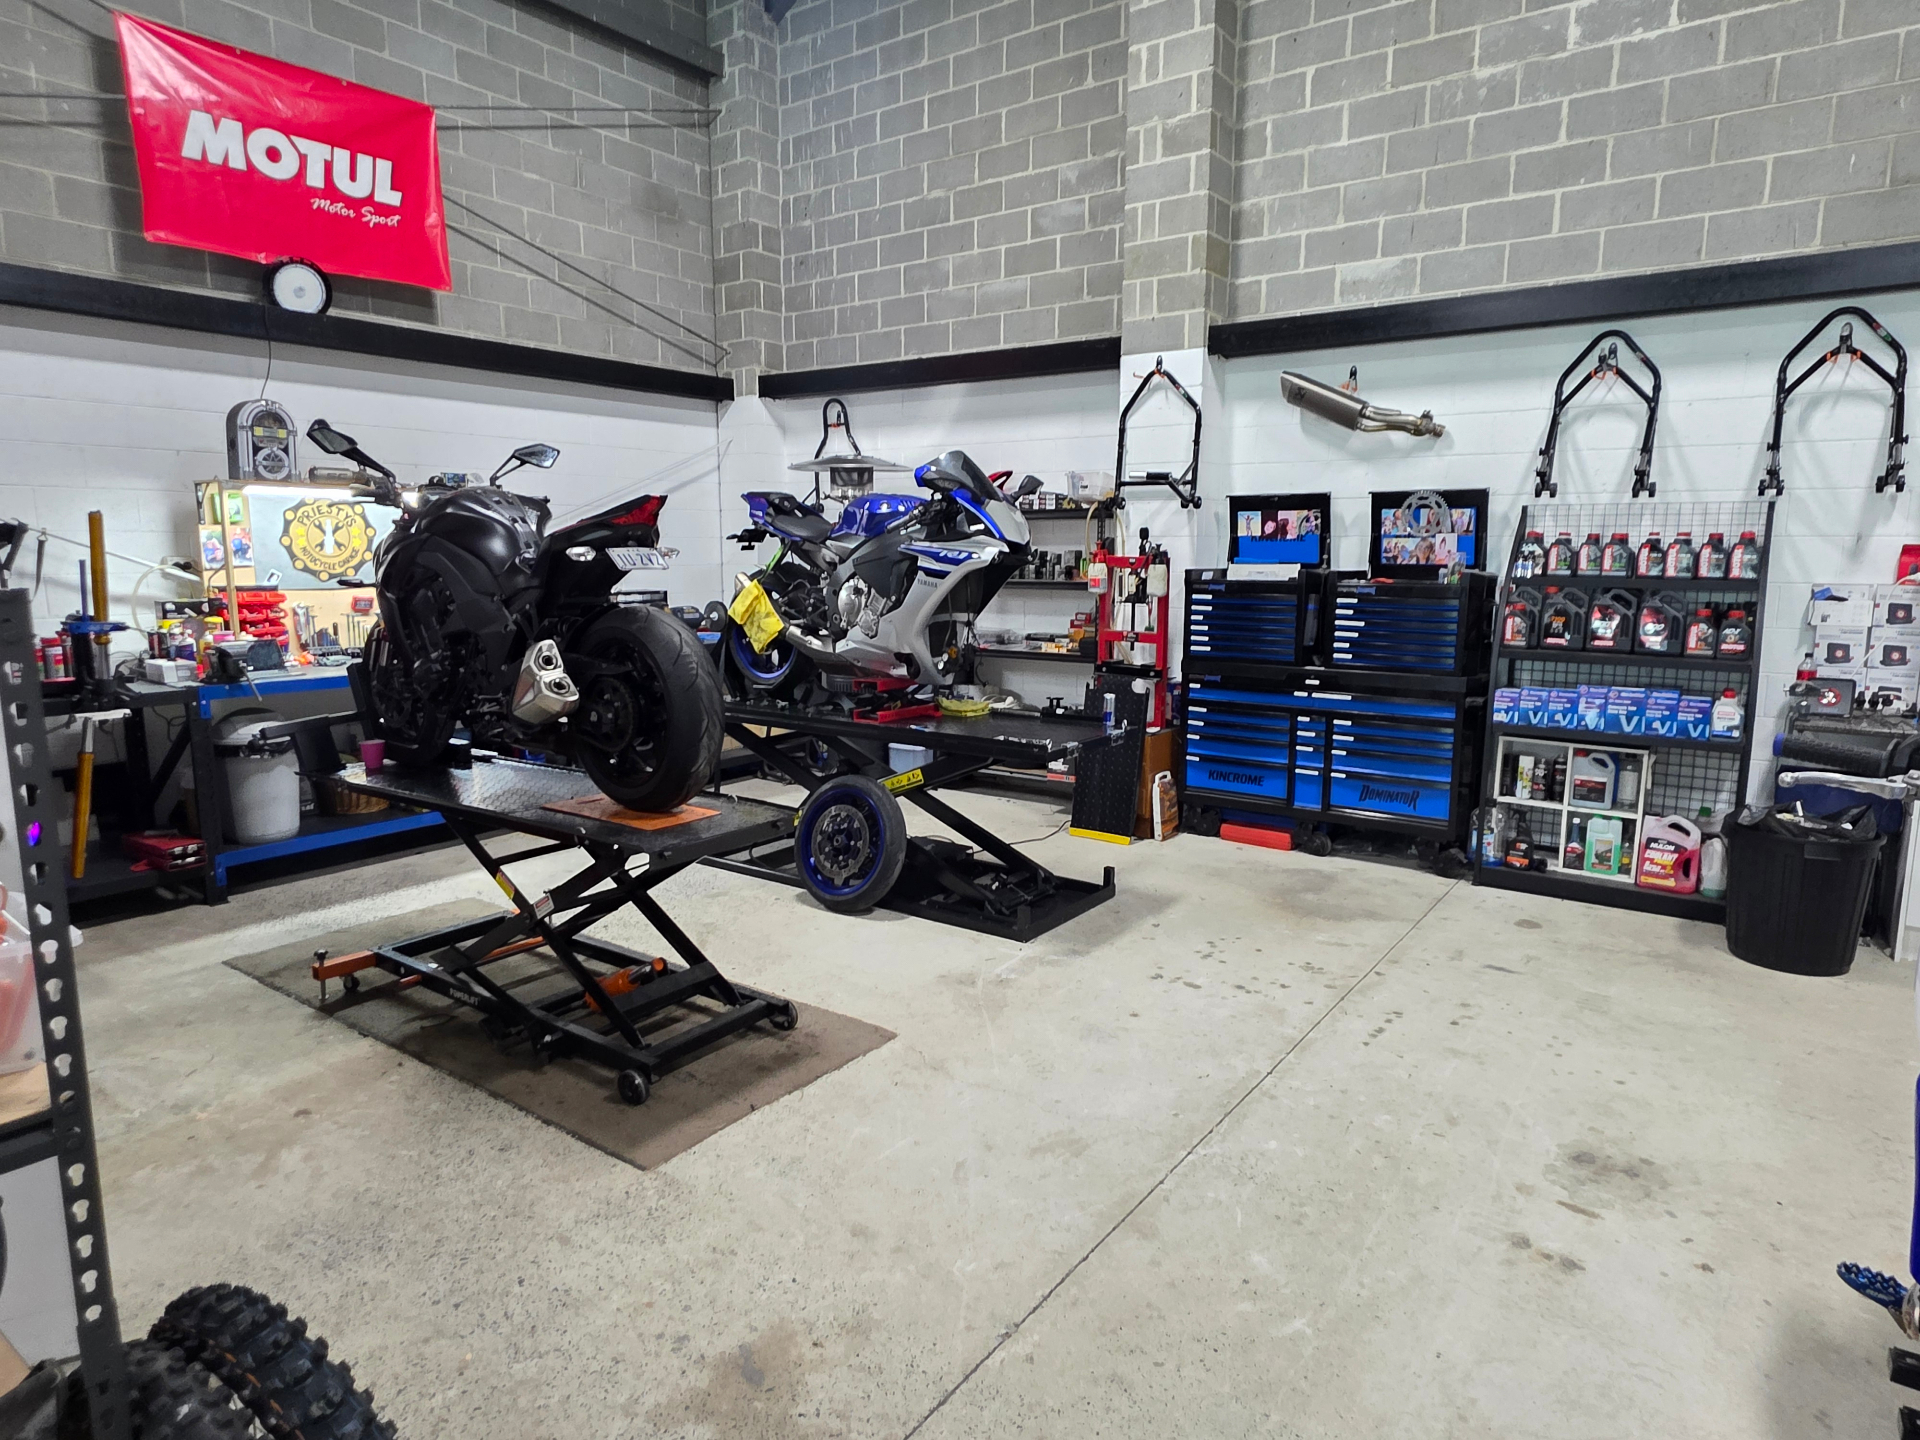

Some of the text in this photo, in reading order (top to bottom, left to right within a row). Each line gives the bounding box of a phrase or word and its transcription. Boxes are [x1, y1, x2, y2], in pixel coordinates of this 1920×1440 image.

[181, 109, 403, 207] MOTUL
[310, 197, 402, 228] Motor Sport
[917, 579, 938, 588] YAMAHA
[1208, 769, 1265, 787] KINCROME
[1358, 784, 1420, 811] DOMINATOR
[1649, 842, 1676, 851] NULON
[450, 987, 479, 1006] POWERLIFT
